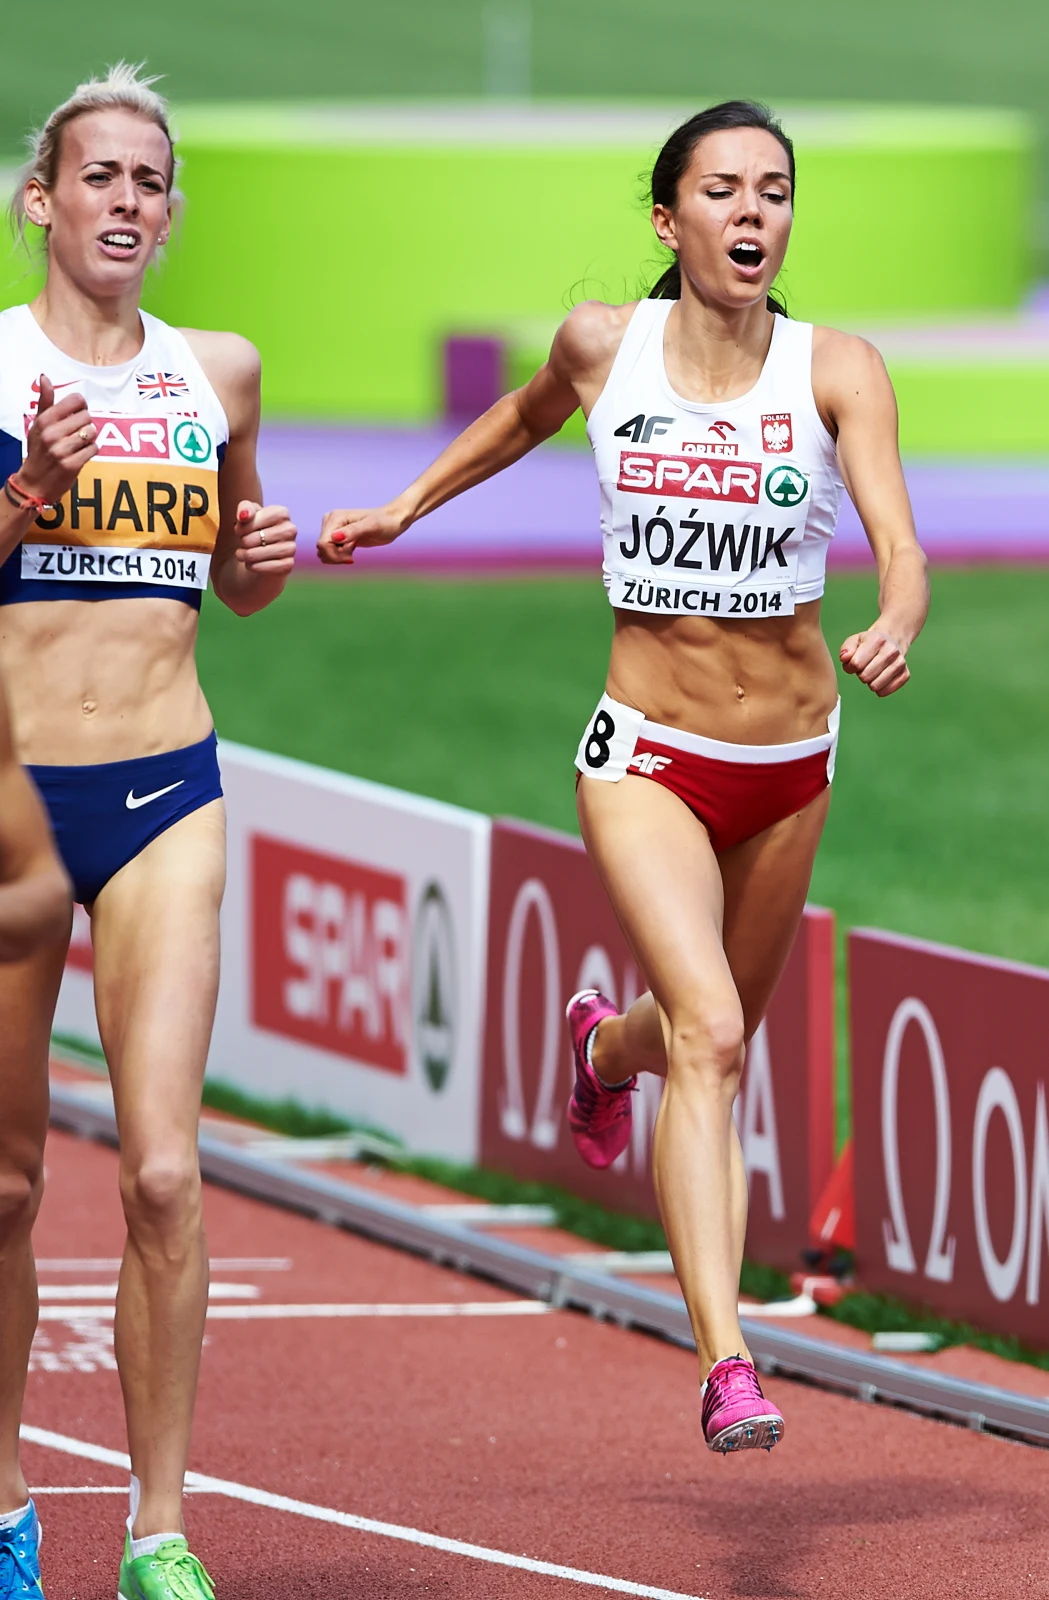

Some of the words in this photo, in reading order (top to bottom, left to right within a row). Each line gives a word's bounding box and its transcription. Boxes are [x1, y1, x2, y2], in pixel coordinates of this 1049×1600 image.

[613, 413, 677, 444] 4F
[683, 443, 736, 456] ORLEN
[620, 456, 758, 499] SPAR
[619, 505, 796, 573] JÓŹWIK
[38, 546, 143, 577] ZÜRICH
[150, 557, 196, 582] 2014
[621, 579, 721, 612] ZÜRICH
[728, 591, 782, 613] 2014
[585, 709, 615, 769] 8
[630, 752, 673, 775] 4F
[283, 870, 410, 1048] SPAR
